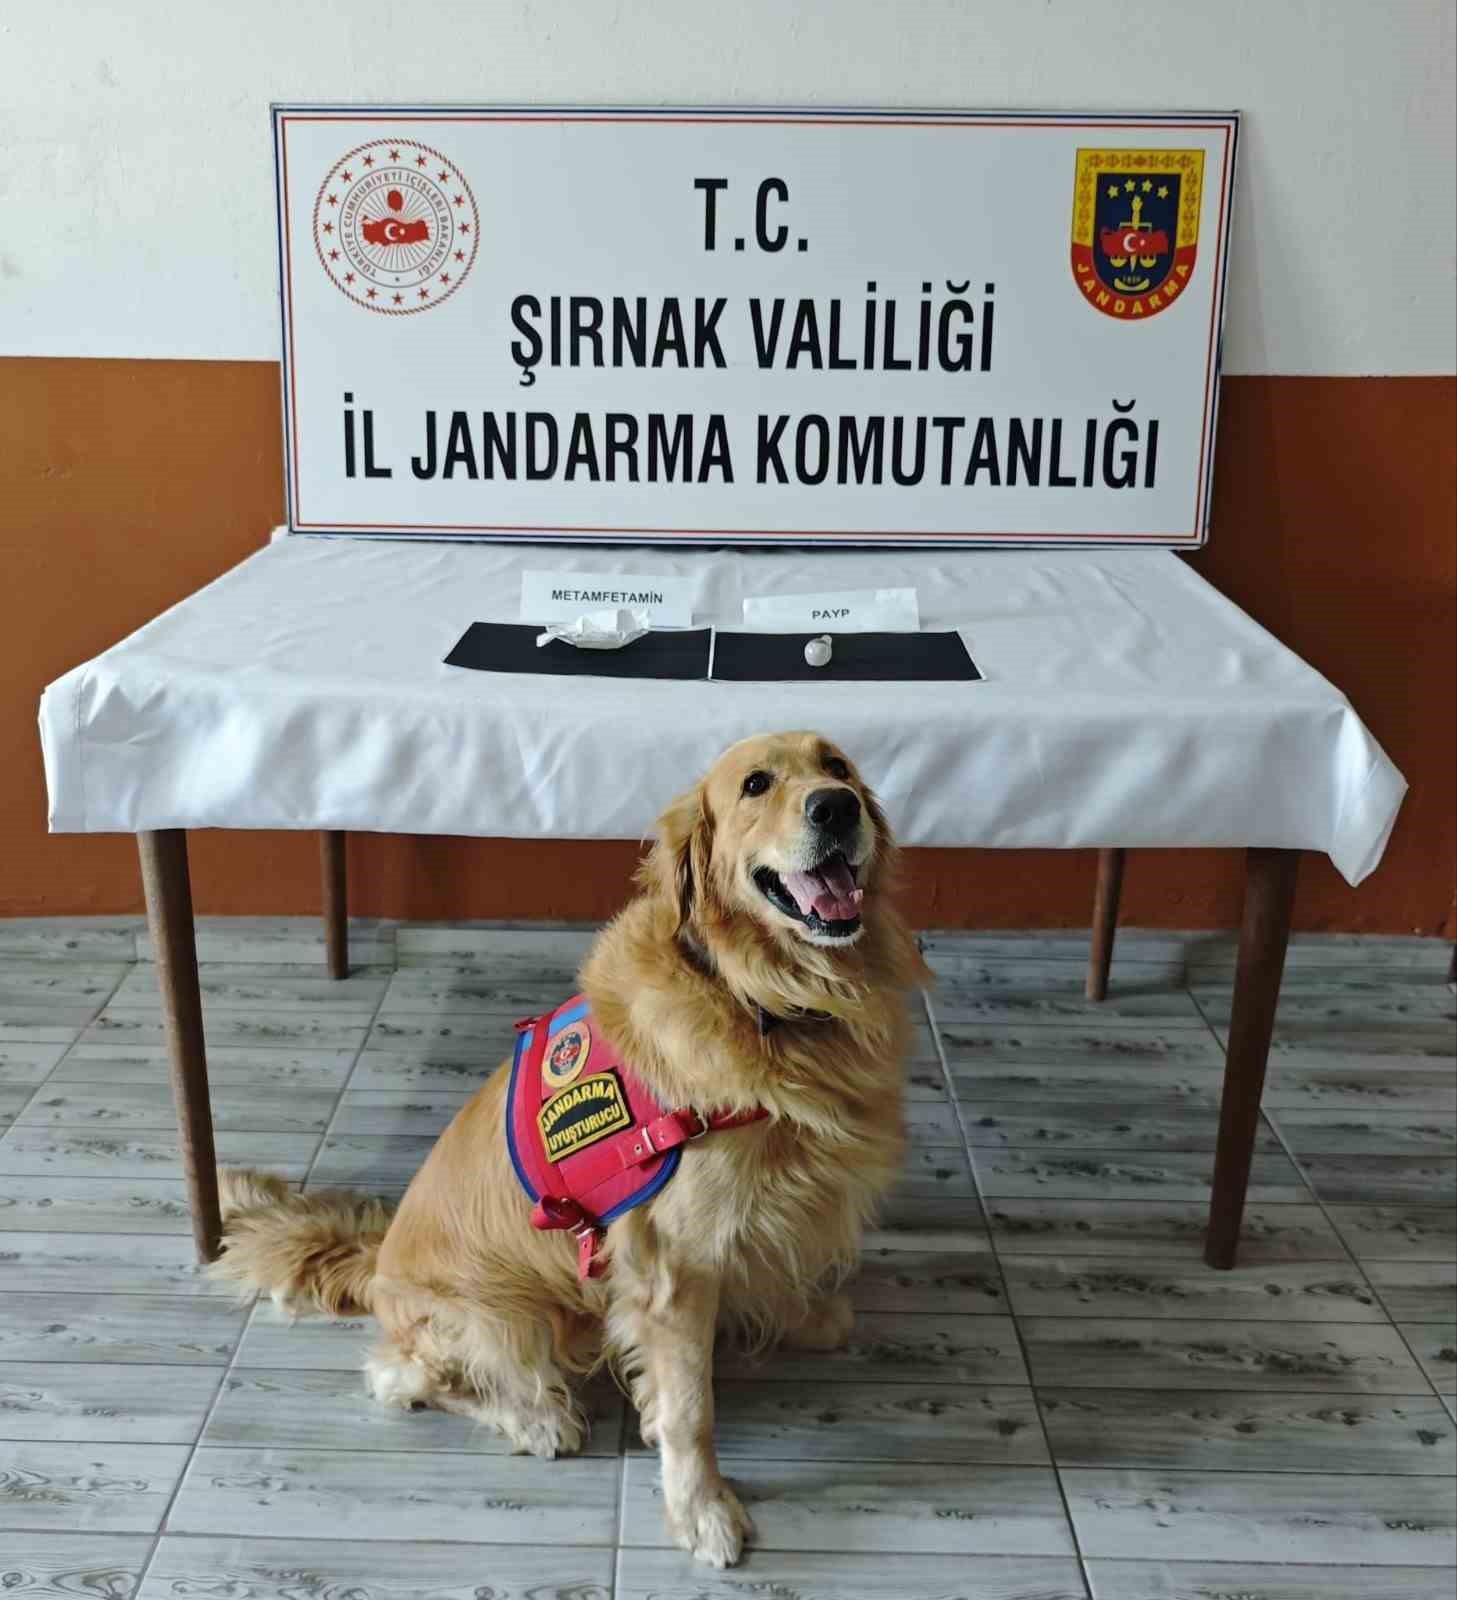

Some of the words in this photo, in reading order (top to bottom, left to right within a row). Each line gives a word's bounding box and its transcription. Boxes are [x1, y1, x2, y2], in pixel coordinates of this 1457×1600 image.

[693, 177, 808, 253] T.C.
[1077, 263, 1189, 315] JANDARMA
[510, 294, 728, 387] ŞIRNAK
[748, 279, 995, 373] VALİLİĞİ
[343, 391, 393, 479] İL
[411, 410, 735, 484] JANDARMA
[756, 399, 1160, 490] KOMUTANLIĞI
[551, 588, 664, 604] METAMFETAMİN
[812, 608, 850, 620] PAYP
[542, 1080, 615, 1132] JANDARMA
[549, 1103, 621, 1150] UYUŞTURUCU
